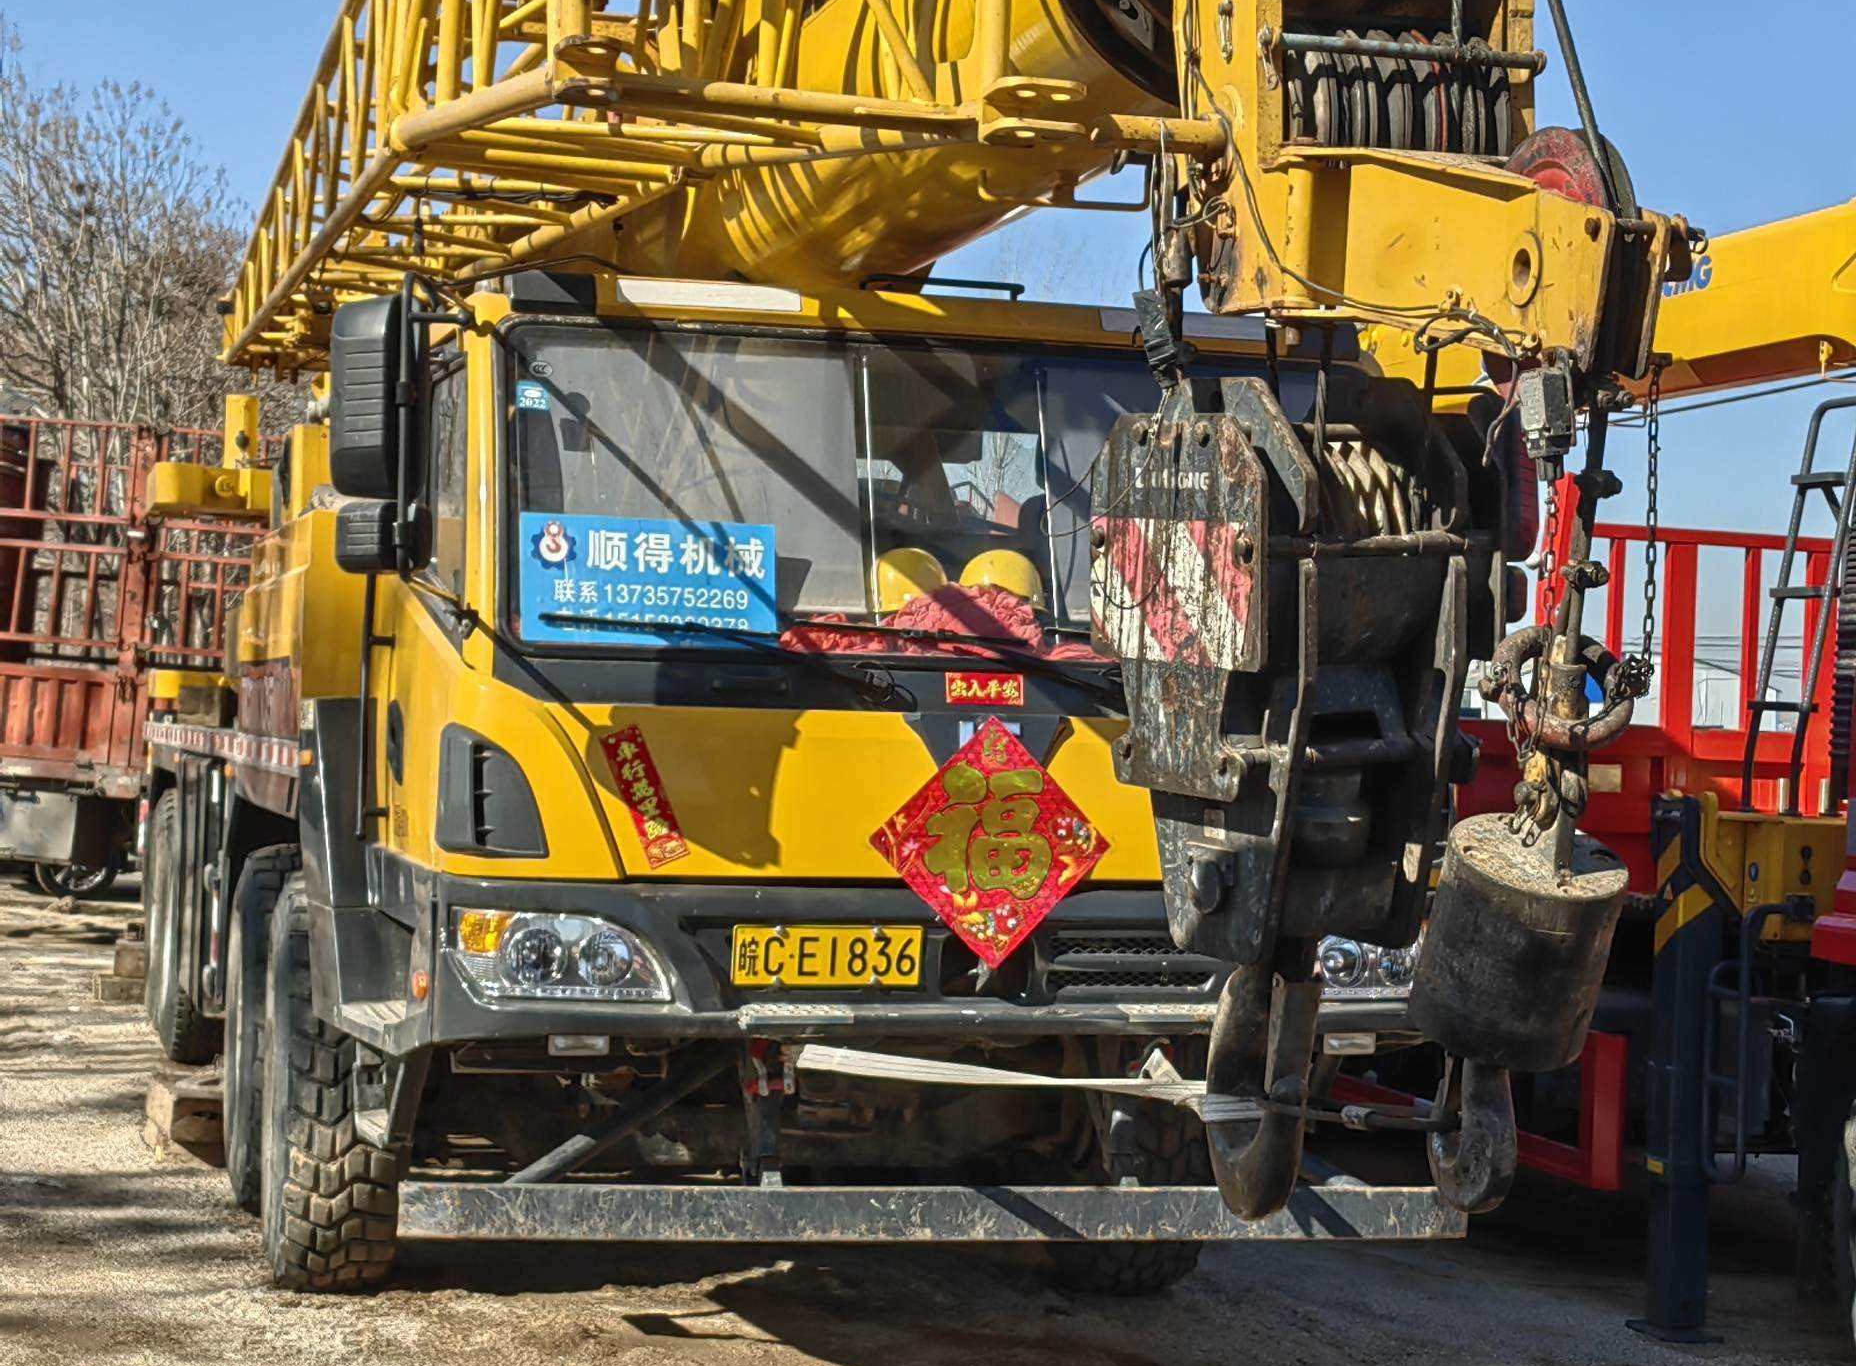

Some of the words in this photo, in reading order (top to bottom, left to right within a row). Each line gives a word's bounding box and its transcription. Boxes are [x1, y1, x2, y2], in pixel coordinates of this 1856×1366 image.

[519, 397, 546, 409] 2022
[586, 530, 766, 579] 顺得机械
[553, 578, 598, 604] 联系
[603, 583, 749, 610] 13735752269
[923, 762, 1054, 900] 福
